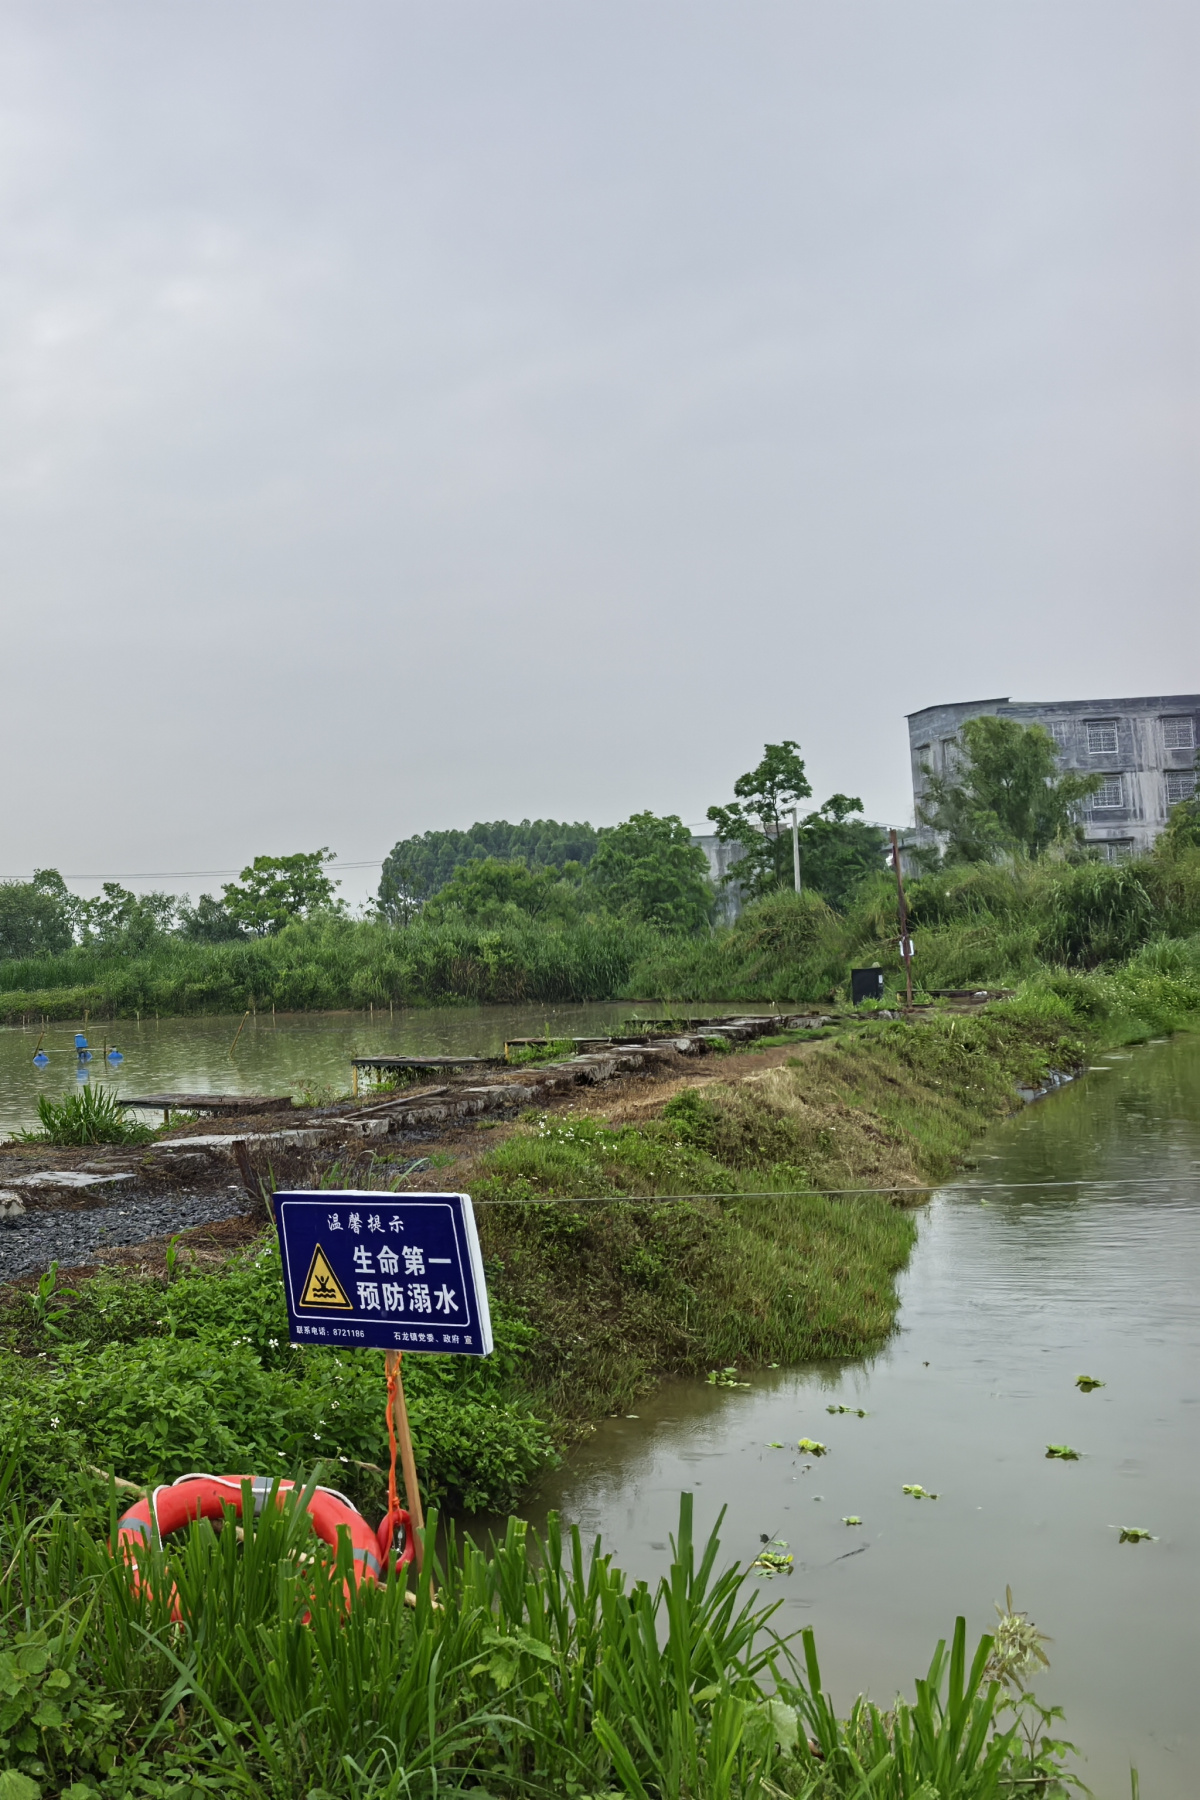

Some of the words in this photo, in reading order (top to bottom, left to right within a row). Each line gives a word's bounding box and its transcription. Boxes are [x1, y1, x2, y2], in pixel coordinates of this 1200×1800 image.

[327, 1212, 405, 1234] 温馨提示
[353, 1245, 452, 1276] 生命第一
[357, 1281, 460, 1315] 预防溺水
